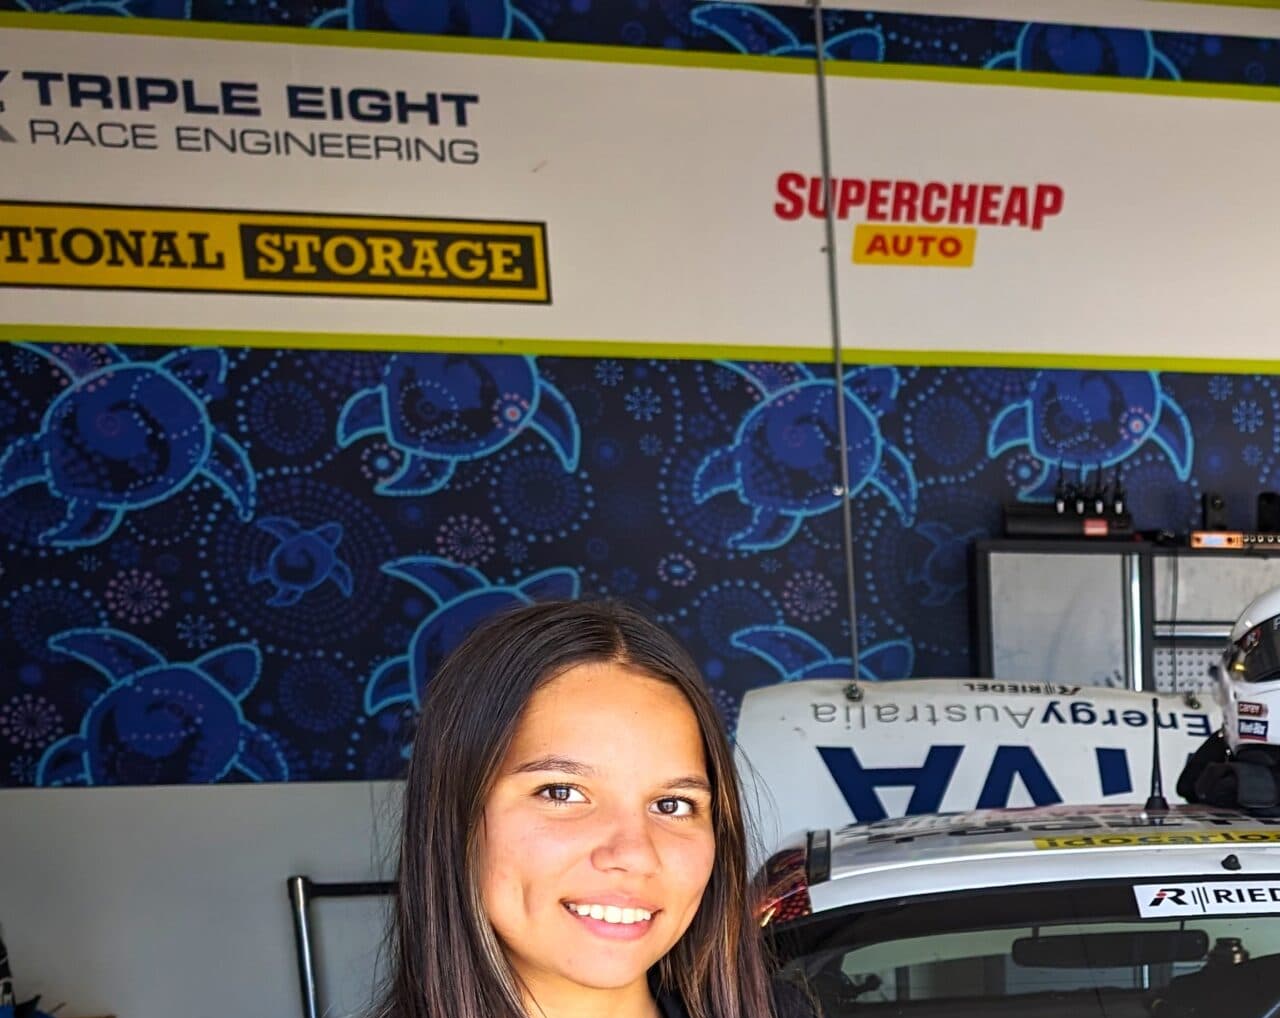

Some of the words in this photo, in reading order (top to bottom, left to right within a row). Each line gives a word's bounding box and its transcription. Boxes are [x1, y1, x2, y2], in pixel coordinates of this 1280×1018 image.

[22, 71, 261, 117] TRIPLE
[286, 84, 479, 127] EIGHT
[30, 119, 158, 150] RACE
[176, 126, 479, 165] ENGINEERING
[774, 172, 1064, 230] SUPERCHEAP
[255, 231, 523, 283] STORAGE
[865, 234, 963, 259] AUTO
[964, 683, 1041, 694] RIEDEL
